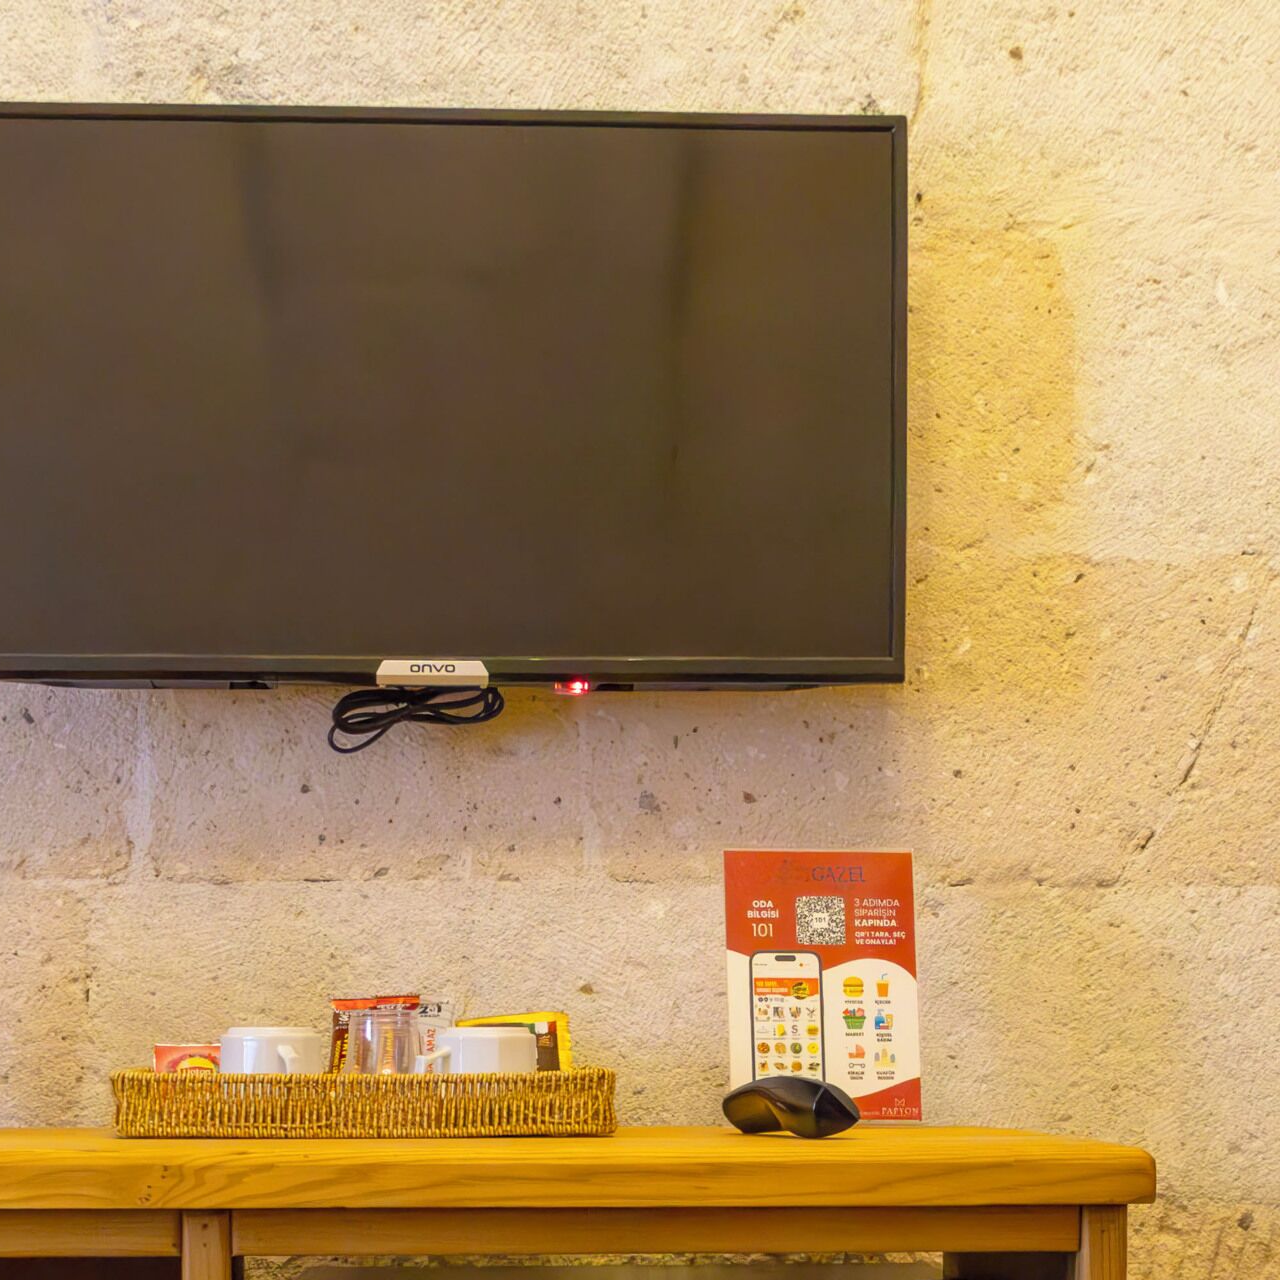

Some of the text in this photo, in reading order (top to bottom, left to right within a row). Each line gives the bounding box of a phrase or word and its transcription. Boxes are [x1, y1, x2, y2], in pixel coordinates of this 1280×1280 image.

[410, 663, 455, 673] onvo
[812, 866, 866, 882] GAZEL
[752, 900, 774, 908] ODA
[854, 898, 900, 907] 3 ADIMDA
[747, 908, 779, 919] BİLGİSİ
[752, 923, 773, 938] 101
